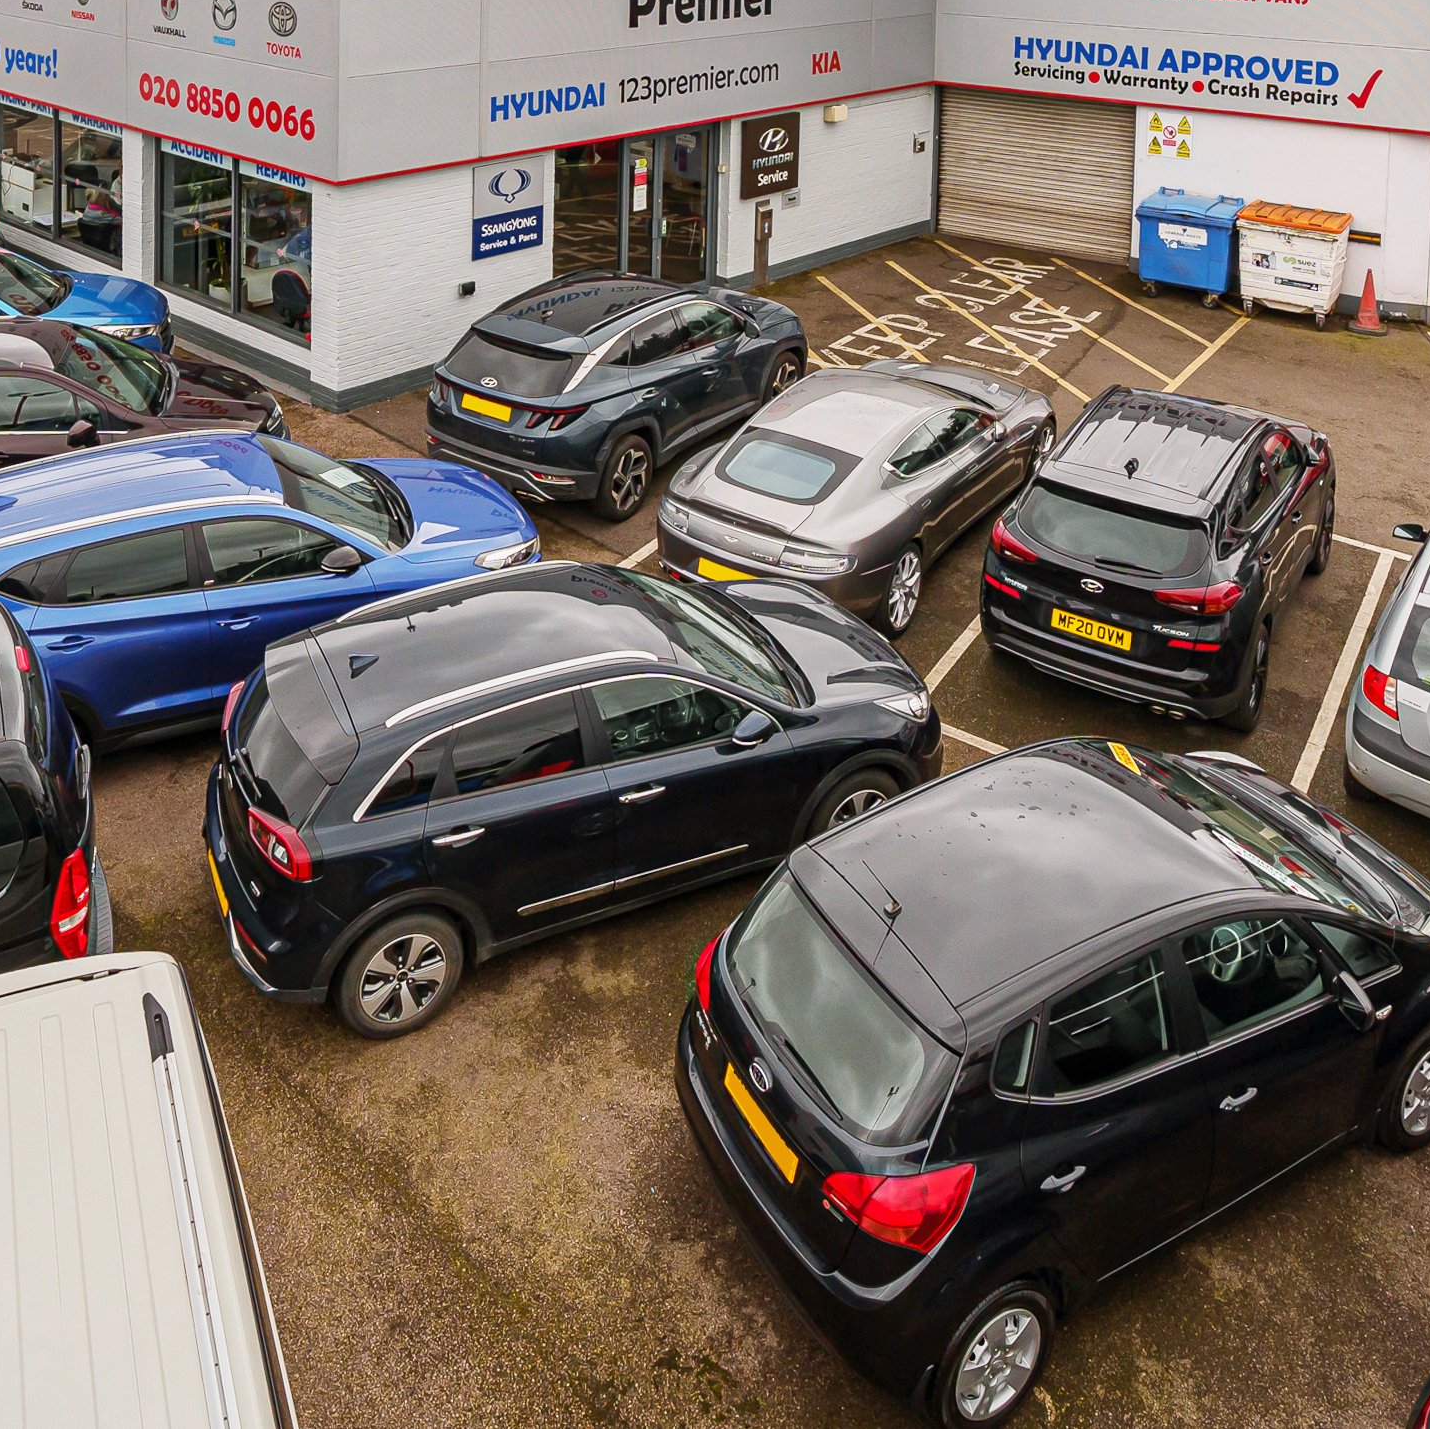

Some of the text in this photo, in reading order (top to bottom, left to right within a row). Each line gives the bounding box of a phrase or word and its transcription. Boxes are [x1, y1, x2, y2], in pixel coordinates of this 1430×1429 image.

[71, 10, 95, 21] NISSAN
[153, 25, 187, 38] VAUXHALL
[266, 42, 302, 59] TOYOTA
[1013, 36, 1340, 87] HYUNDAI APPROVED
[5, 48, 59, 79] years!
[811, 50, 842, 76] KIA
[489, 62, 779, 123] HYUNDAI 123premier.com
[1013, 61, 1339, 109] Servicing Warranty Crash Repairs
[31, 101, 55, 115] PART
[139, 72, 316, 141] 020 8850 0066
[752, 151, 794, 170] HYUNDAI
[757, 170, 789, 187] Service
[479, 232, 538, 252] Service & Parts
[942, 297, 1102, 376] LEASE
[1058, 613, 1125, 646] MF20 OVM
[1152, 624, 1190, 637] TUCSON
